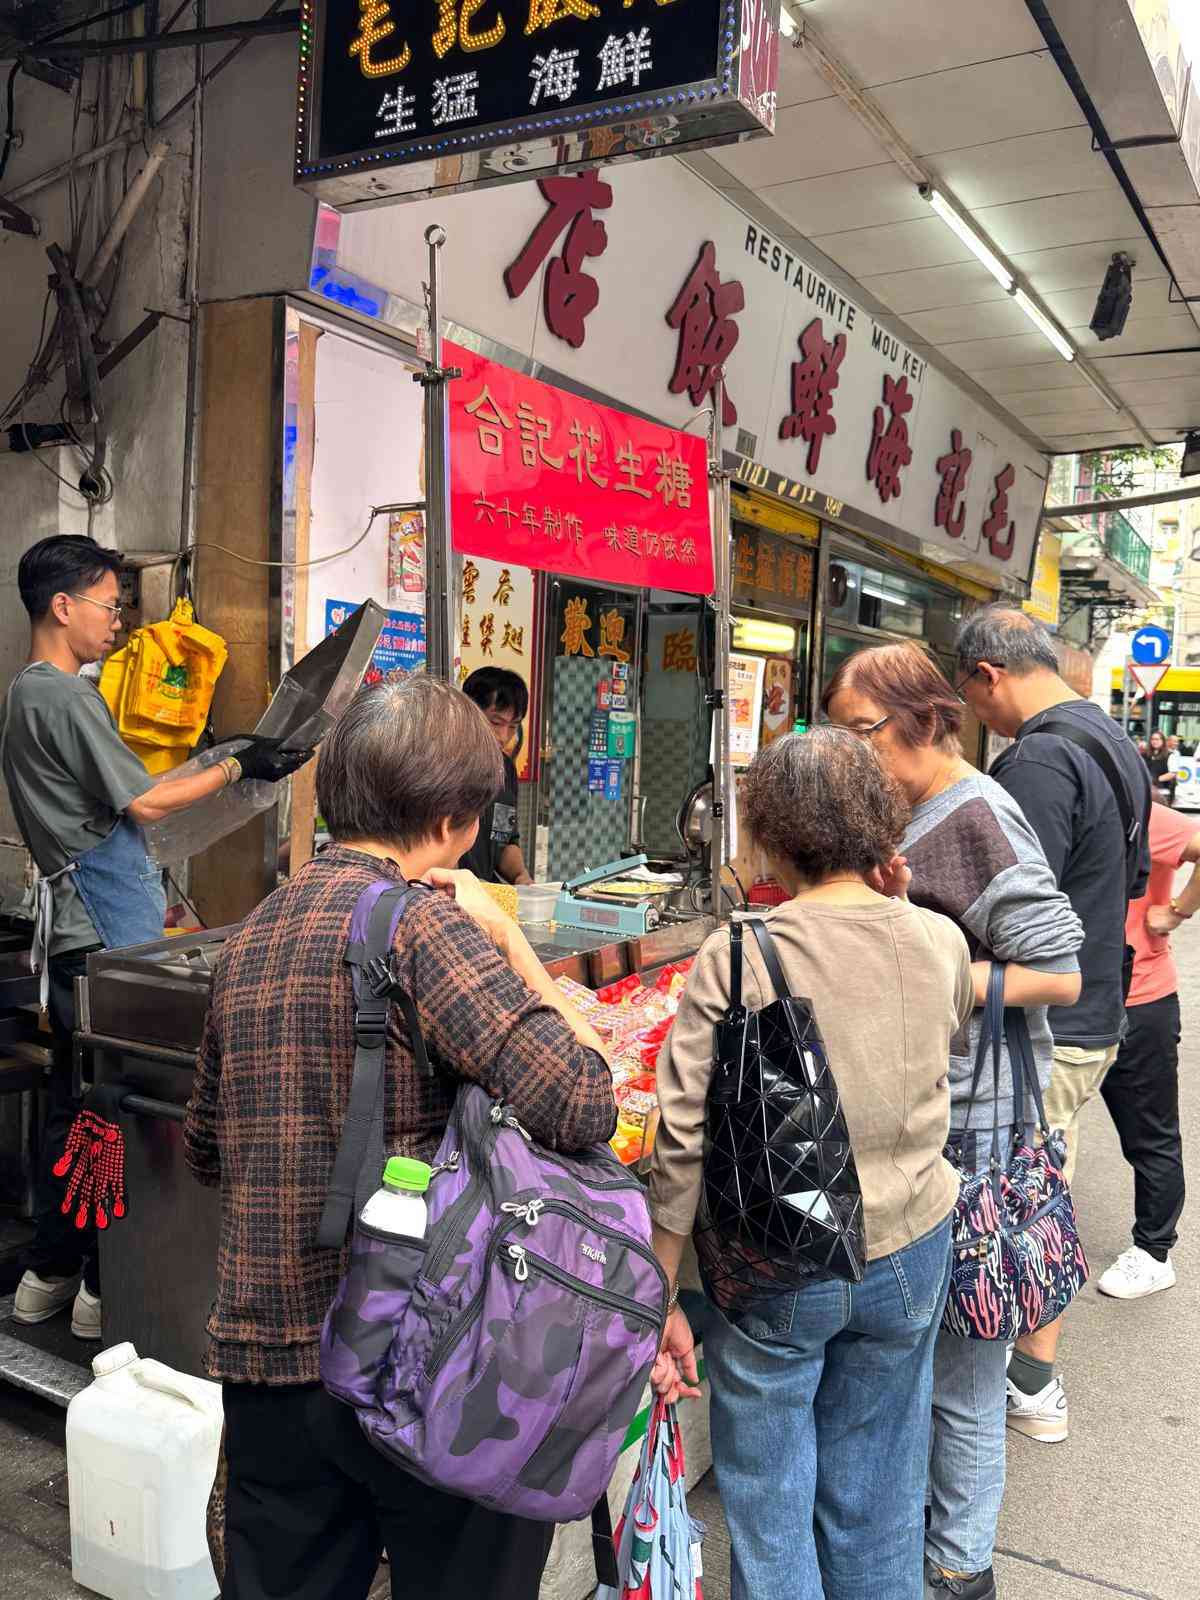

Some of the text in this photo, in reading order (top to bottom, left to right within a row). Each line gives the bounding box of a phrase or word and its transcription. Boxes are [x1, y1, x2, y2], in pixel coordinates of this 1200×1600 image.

[374, 26, 653, 138] 生猛 海鮮
[745, 225, 856, 331] RESTAURNTE
[464, 384, 694, 510] 合記花生糖
[473, 488, 584, 545] 六十年制作
